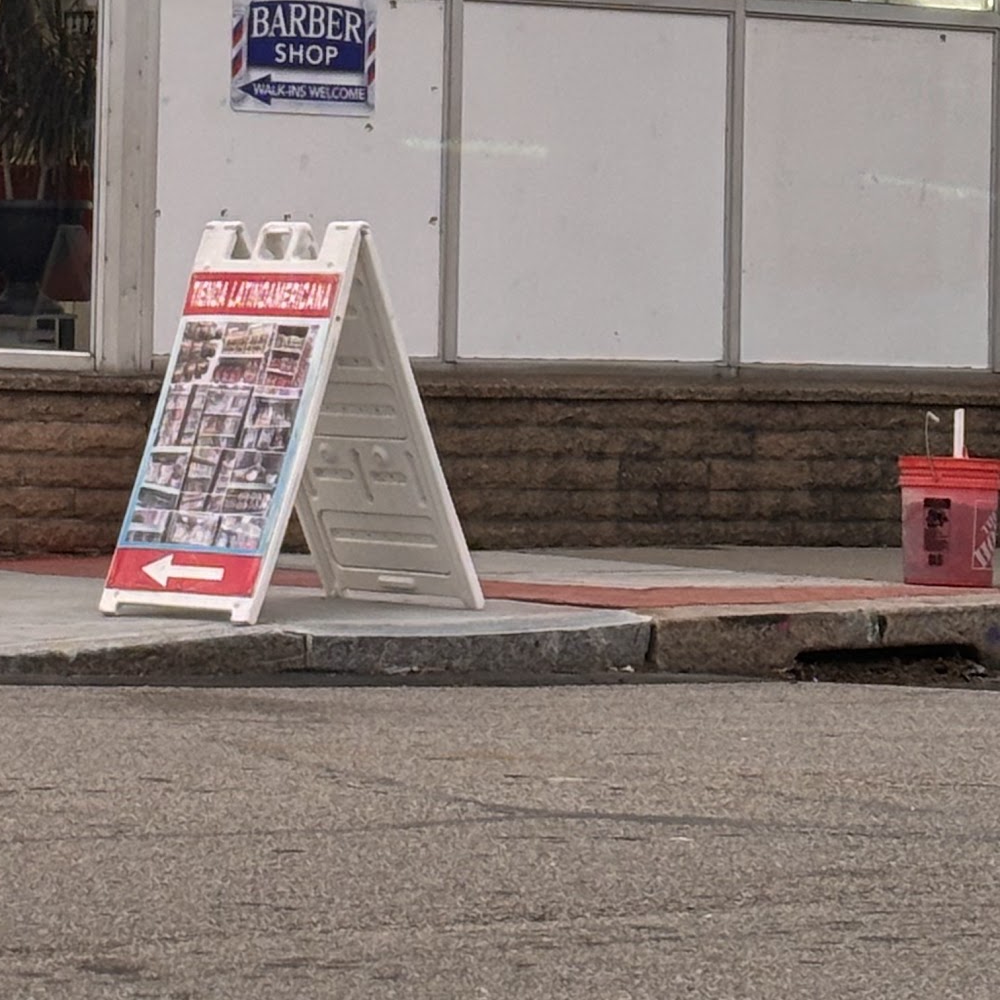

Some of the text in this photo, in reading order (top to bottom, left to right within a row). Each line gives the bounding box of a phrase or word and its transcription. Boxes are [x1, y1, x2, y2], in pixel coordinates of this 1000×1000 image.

[250, 2, 364, 45] BARBER
[274, 42, 339, 66] SHOP
[252, 82, 366, 101] WALK-INS WELCOME
